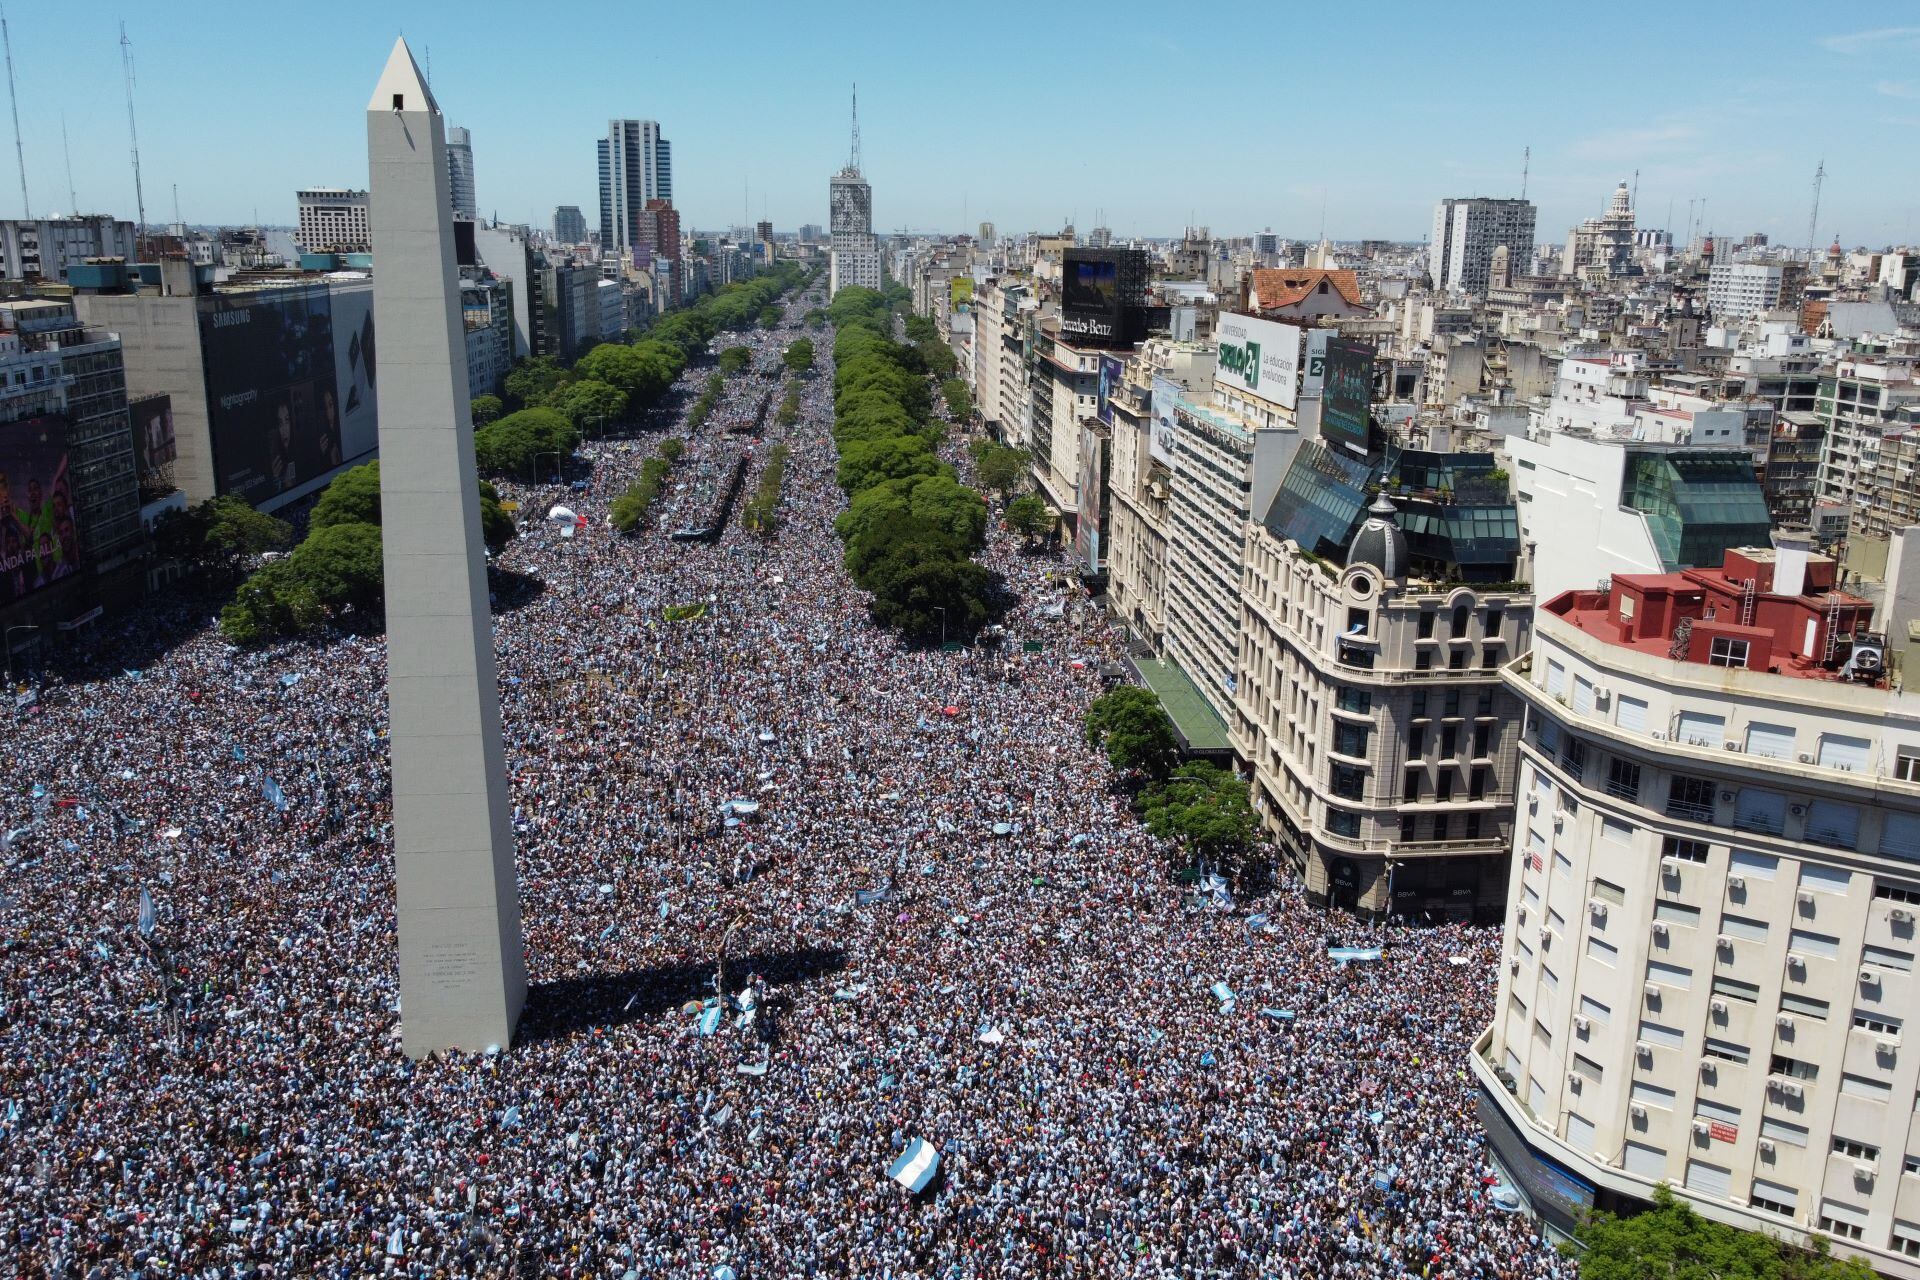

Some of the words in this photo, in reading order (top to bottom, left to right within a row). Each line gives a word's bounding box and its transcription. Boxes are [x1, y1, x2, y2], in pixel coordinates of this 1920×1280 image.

[213, 308, 251, 329] SAMSUNG
[1263, 351, 1269, 364] La
[1245, 349, 1256, 383] 21
[1334, 878, 1353, 888] BBVA
[1397, 890, 1416, 898] BBVA
[1452, 888, 1472, 896] BBVA
